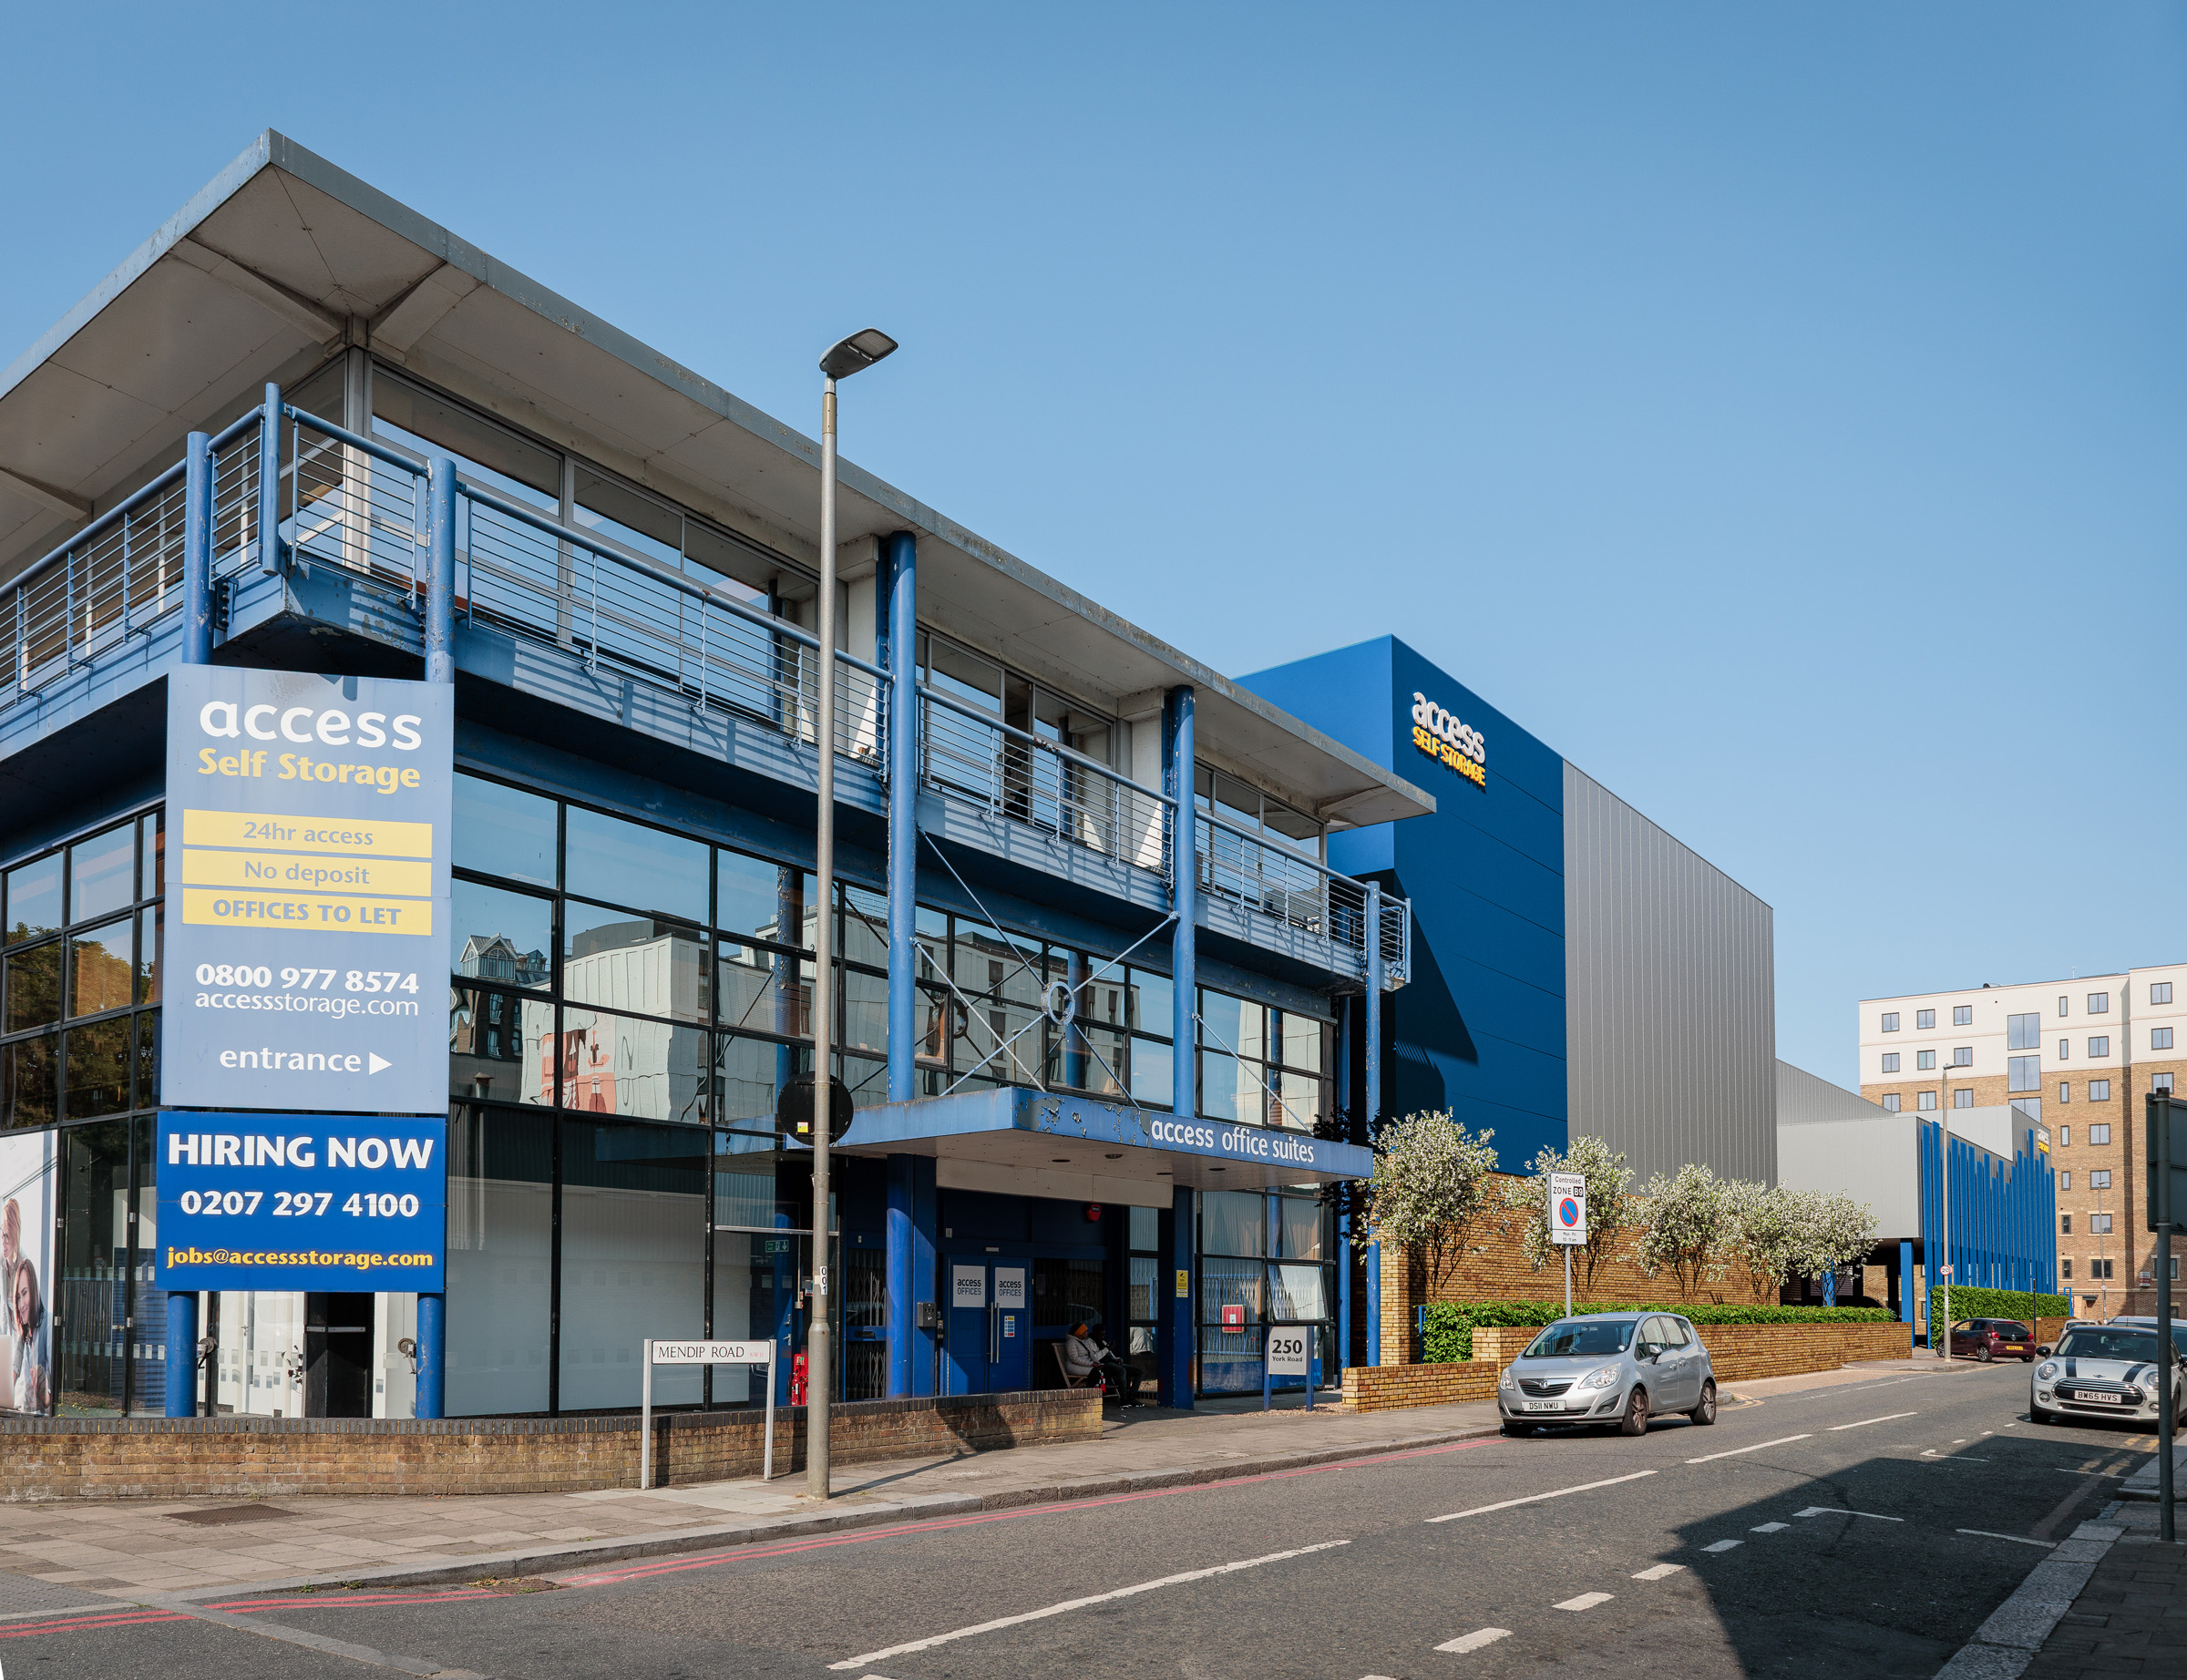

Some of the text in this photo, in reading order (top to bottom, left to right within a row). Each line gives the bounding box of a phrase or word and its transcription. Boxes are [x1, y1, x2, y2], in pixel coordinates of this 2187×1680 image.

[200, 701, 422, 751] access
[1412, 691, 1485, 763] access
[1412, 726, 1485, 786] SELF STORAGE
[198, 747, 421, 794] Self Storage
[243, 821, 374, 845] 24hr access
[244, 861, 370, 887] No deposit
[213, 899, 401, 926] OFFICES TO LET
[195, 963, 419, 994] 0800 977 8574
[195, 992, 418, 1019] accessstorage.com
[220, 1047, 361, 1072] entrance
[169, 1133, 434, 1169] HIRING NOW
[1151, 1120, 1314, 1163] access office suites
[1553, 1187, 1583, 1196] ZONE B9
[1555, 1176, 1581, 1184] Controlled
[181, 1191, 419, 1217] 0207 297 4100
[167, 1247, 433, 1270] jobs@accessstorage.com
[658, 1347, 705, 1358] MENDIP
[711, 1347, 744, 1358] ROAD
[1272, 1339, 1302, 1354] 250
[2078, 1392, 2099, 1400] BW65
